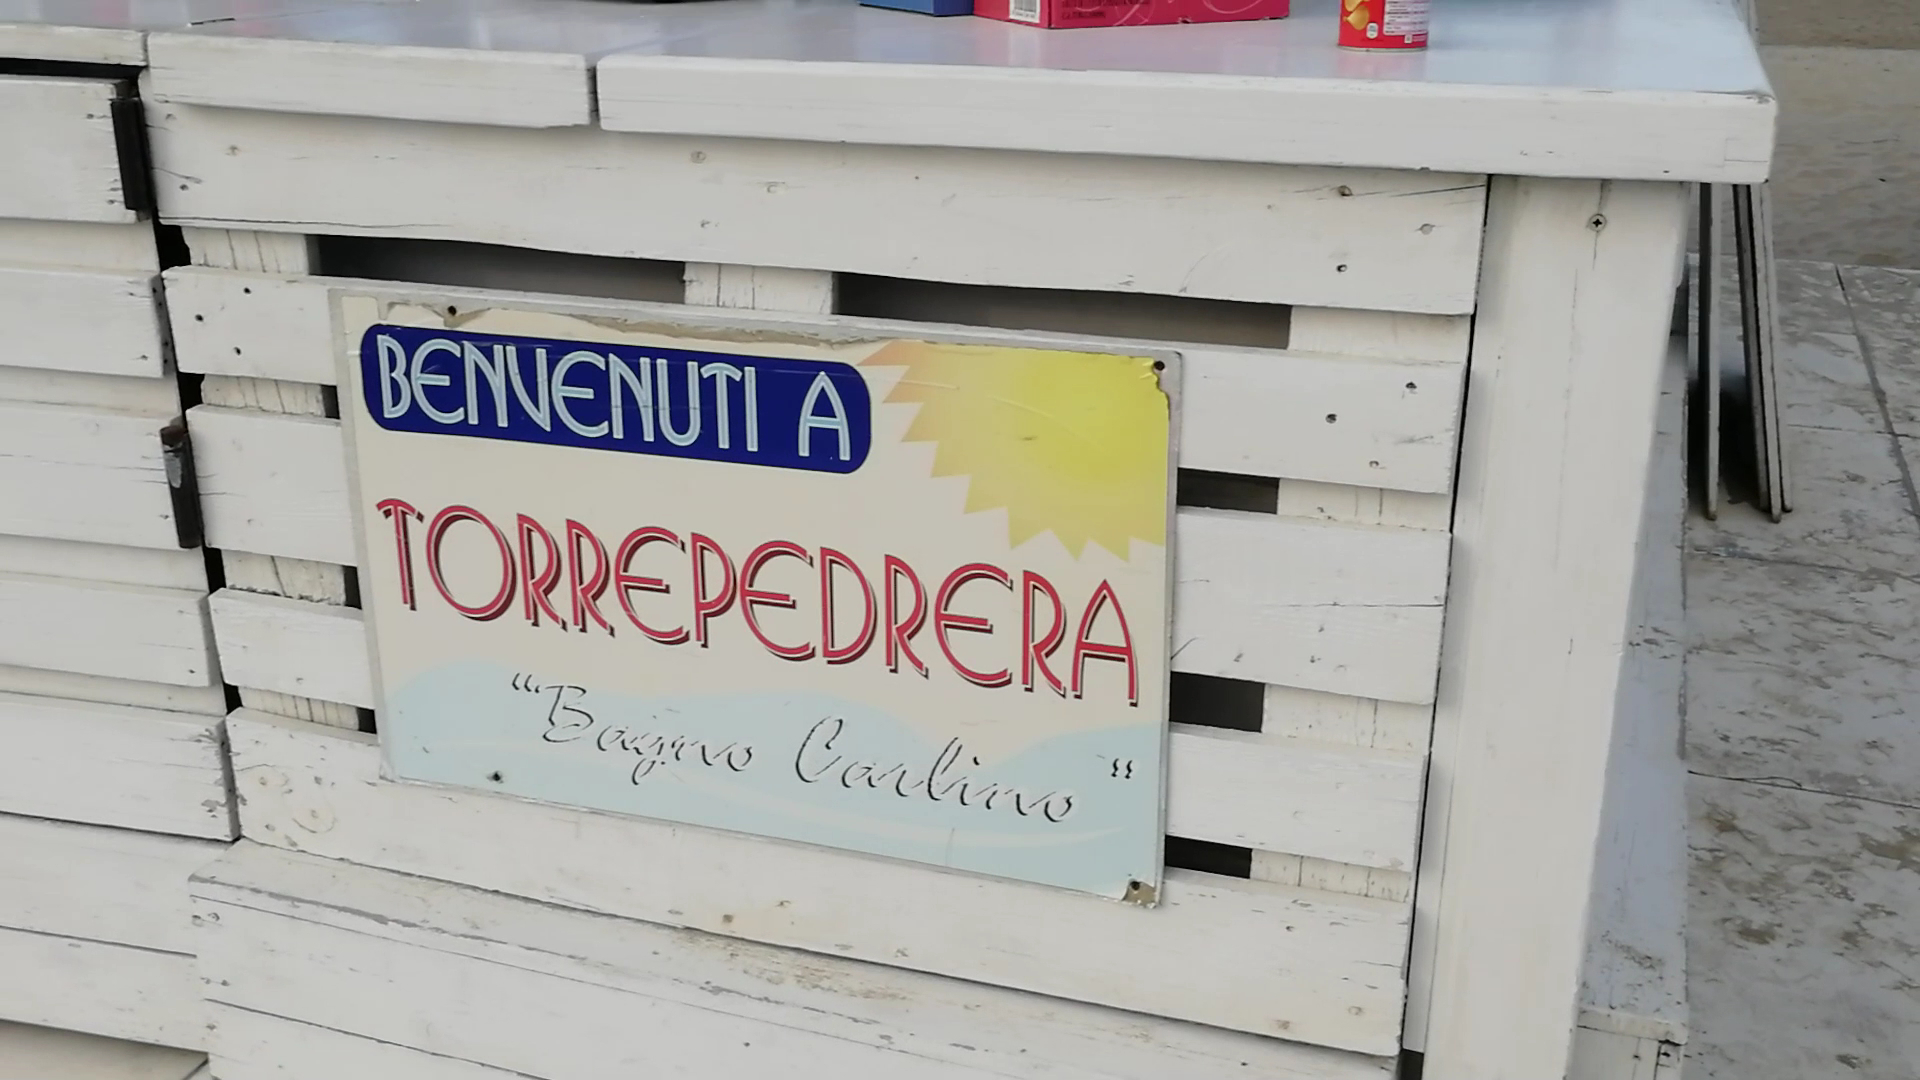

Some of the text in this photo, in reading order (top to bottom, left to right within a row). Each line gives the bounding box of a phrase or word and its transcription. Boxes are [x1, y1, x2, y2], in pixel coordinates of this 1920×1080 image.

[376, 333, 852, 461] BENVENUTI A
[376, 498, 1139, 707] TORREPEDRERA
